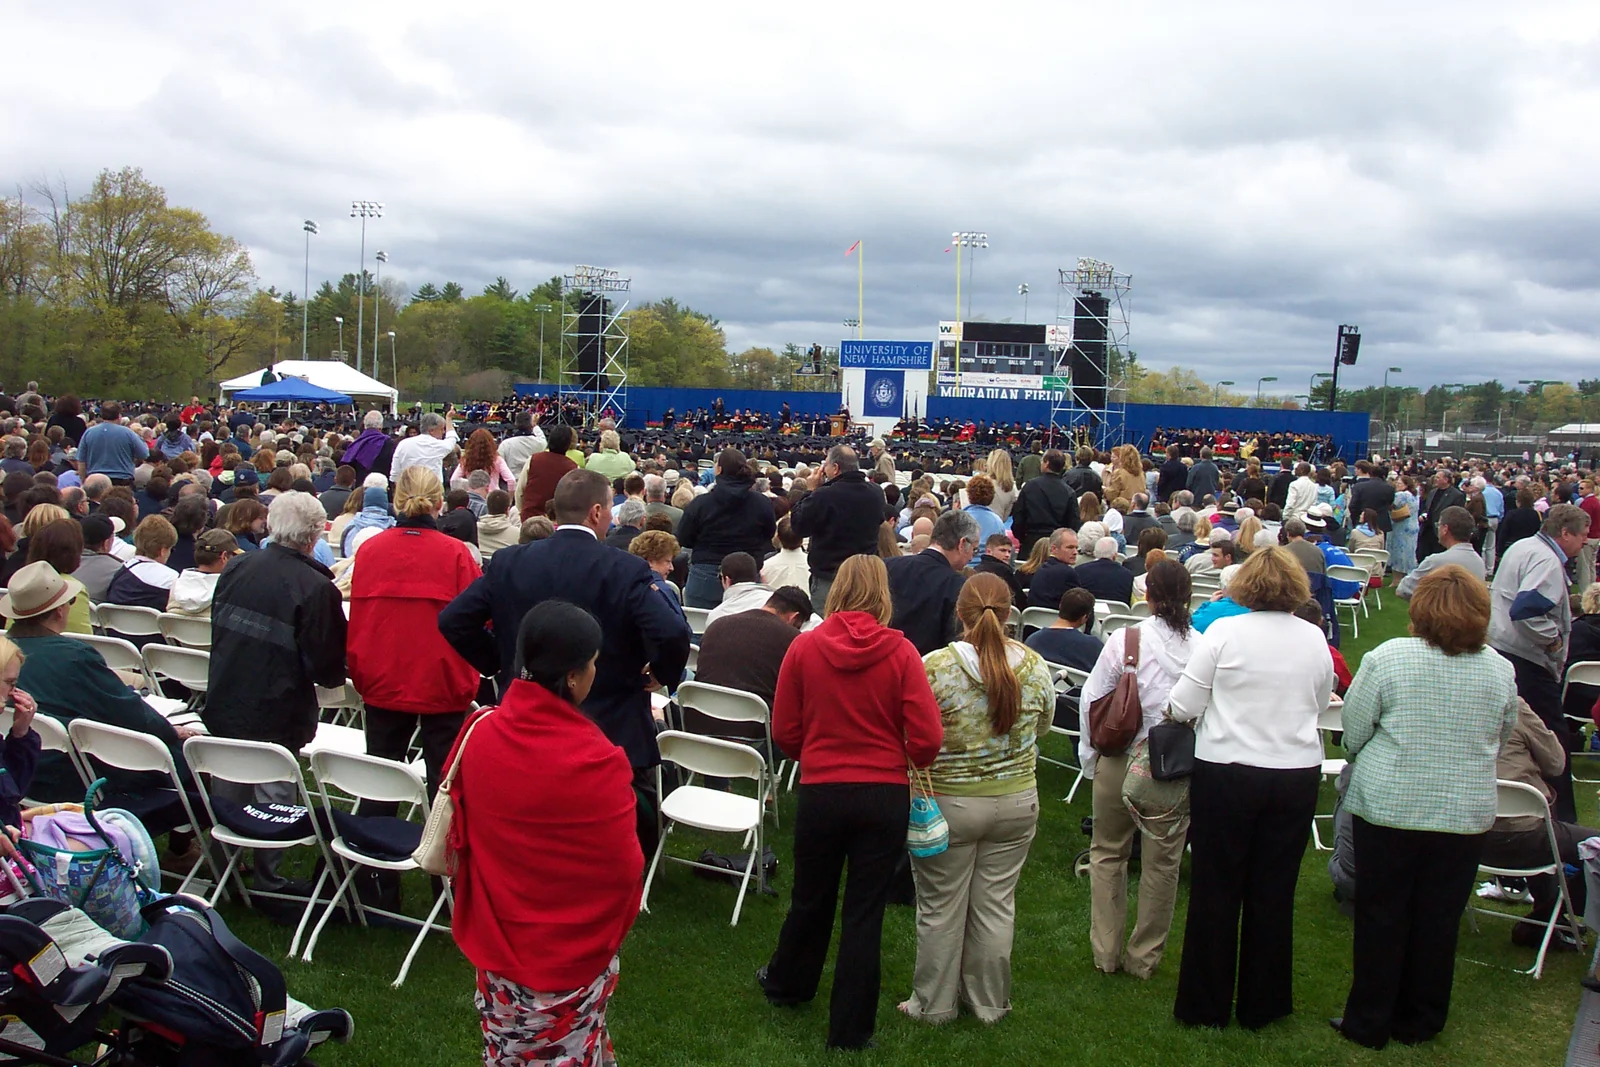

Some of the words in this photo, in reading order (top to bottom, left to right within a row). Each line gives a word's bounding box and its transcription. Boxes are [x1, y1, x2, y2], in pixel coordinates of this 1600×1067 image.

[844, 344, 908, 354] UNIVERSITY
[913, 346, 929, 356] OF
[844, 355, 867, 364] NEW
[872, 356, 928, 365] HAMPSHIRE
[940, 386, 1019, 399] MOORADIAN
[1025, 390, 1063, 401] FIELD
[243, 804, 273, 820] NEW
